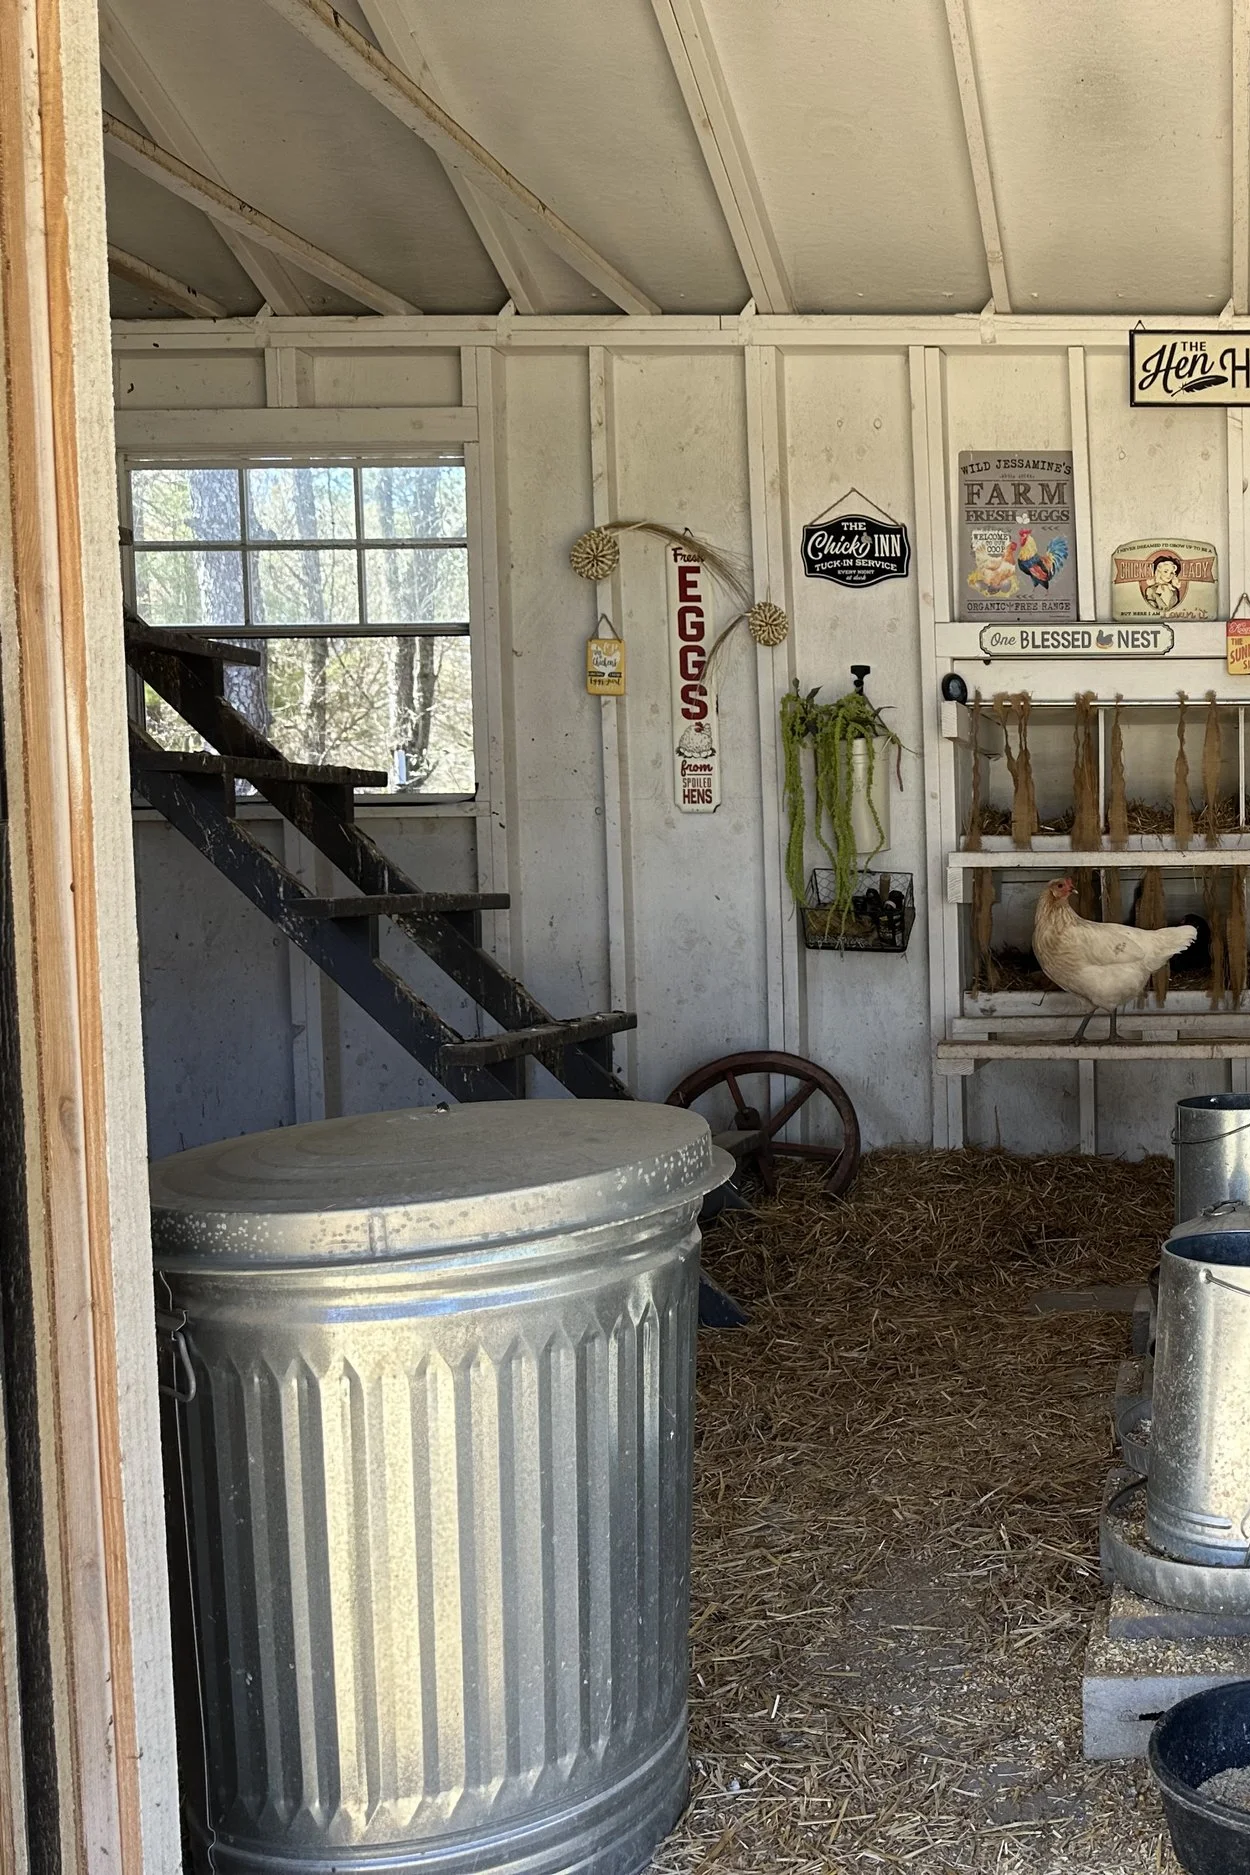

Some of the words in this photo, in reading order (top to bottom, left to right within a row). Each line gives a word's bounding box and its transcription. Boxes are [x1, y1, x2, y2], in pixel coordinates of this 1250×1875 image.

[1181, 341, 1206, 351] THE
[1138, 342, 1214, 393] Hen
[961, 461, 991, 475] WILD
[996, 459, 1072, 475] JESSAMINE'S
[964, 482, 1067, 505] FARM
[965, 510, 1017, 521] FRESH
[1028, 510, 1070, 521] EGGS
[841, 522, 867, 531] THE
[807, 530, 871, 560] Chick
[874, 534, 901, 557] INN
[855, 559, 898, 572] SERVICE
[1120, 562, 1154, 579] CHICKEN
[1183, 561, 1209, 578] LADY
[967, 602, 1006, 611] ORGANIC
[1014, 602, 1038, 611] FREE
[1041, 602, 1071, 611] RANGE
[677, 566, 708, 720] EGGS
[990, 632, 1017, 647] One
[1020, 630, 1092, 649] BLESSED
[1117, 630, 1161, 649] NEST
[681, 759, 713, 777] from
[683, 778, 711, 788] SPOILED
[683, 789, 713, 804] HENS
